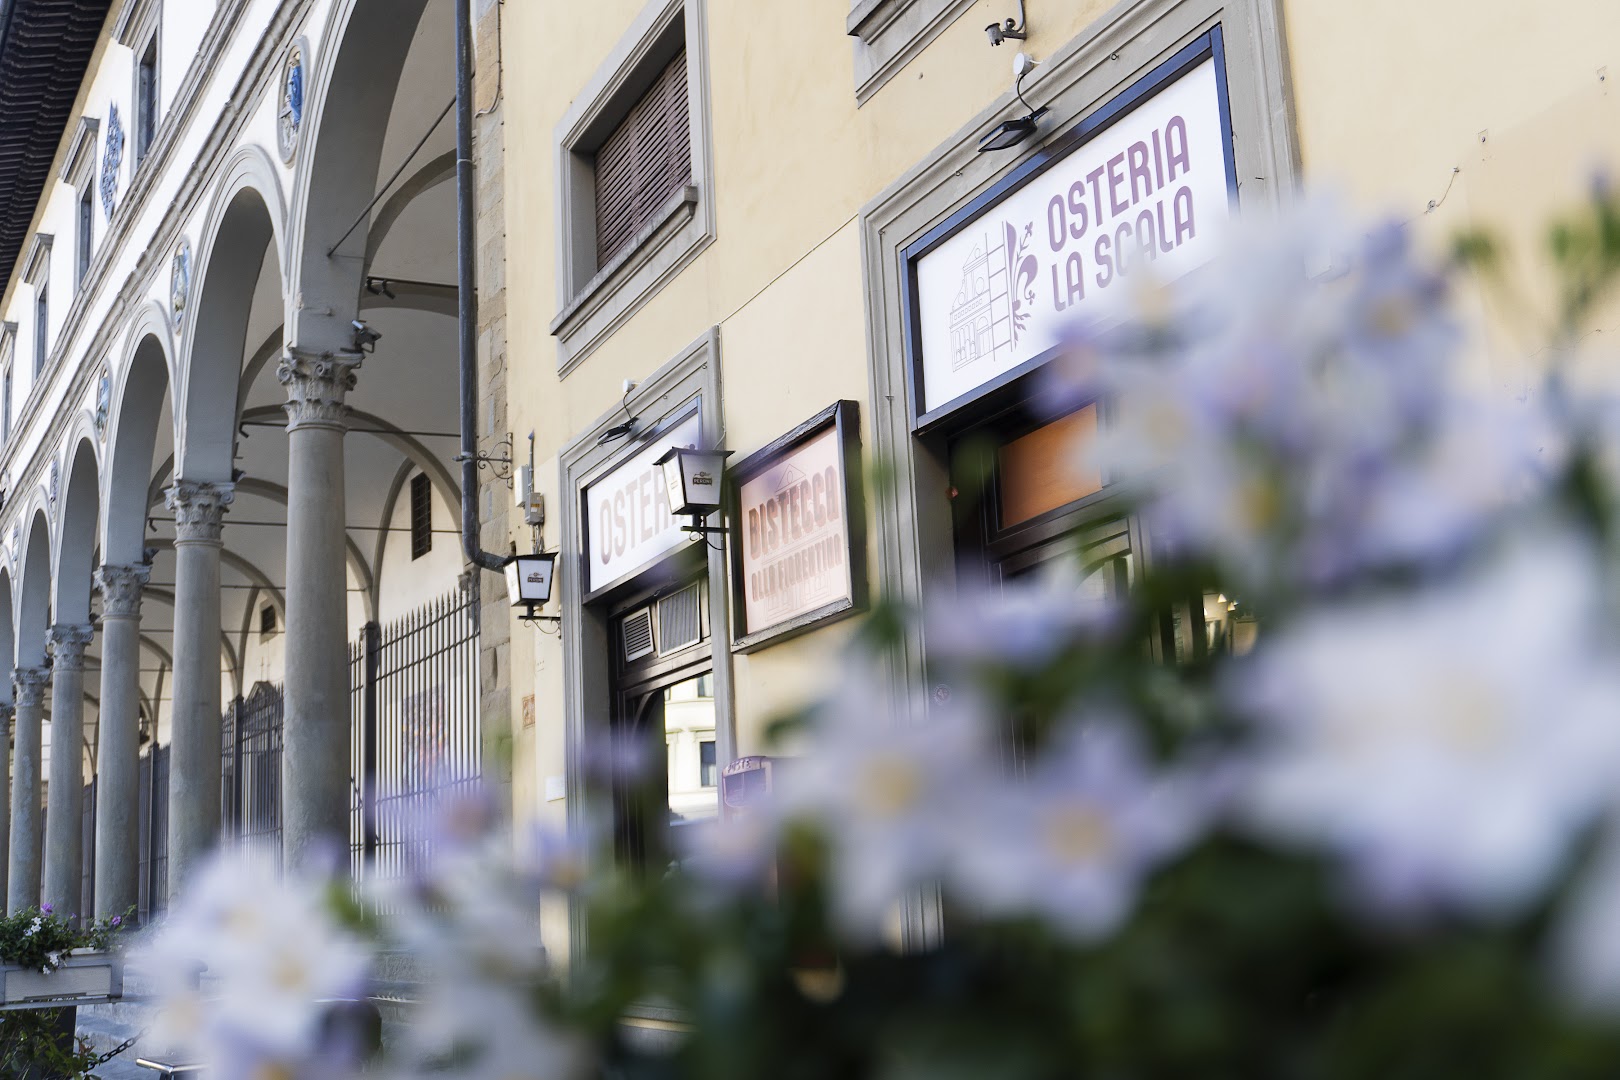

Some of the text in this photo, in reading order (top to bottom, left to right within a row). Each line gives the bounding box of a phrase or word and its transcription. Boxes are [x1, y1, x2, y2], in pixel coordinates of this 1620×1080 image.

[1047, 115, 1191, 252] OSTERIA
[1051, 185, 1196, 312] LA SCALA
[600, 444, 695, 566] OSTER
[749, 465, 840, 560] BISTECCA
